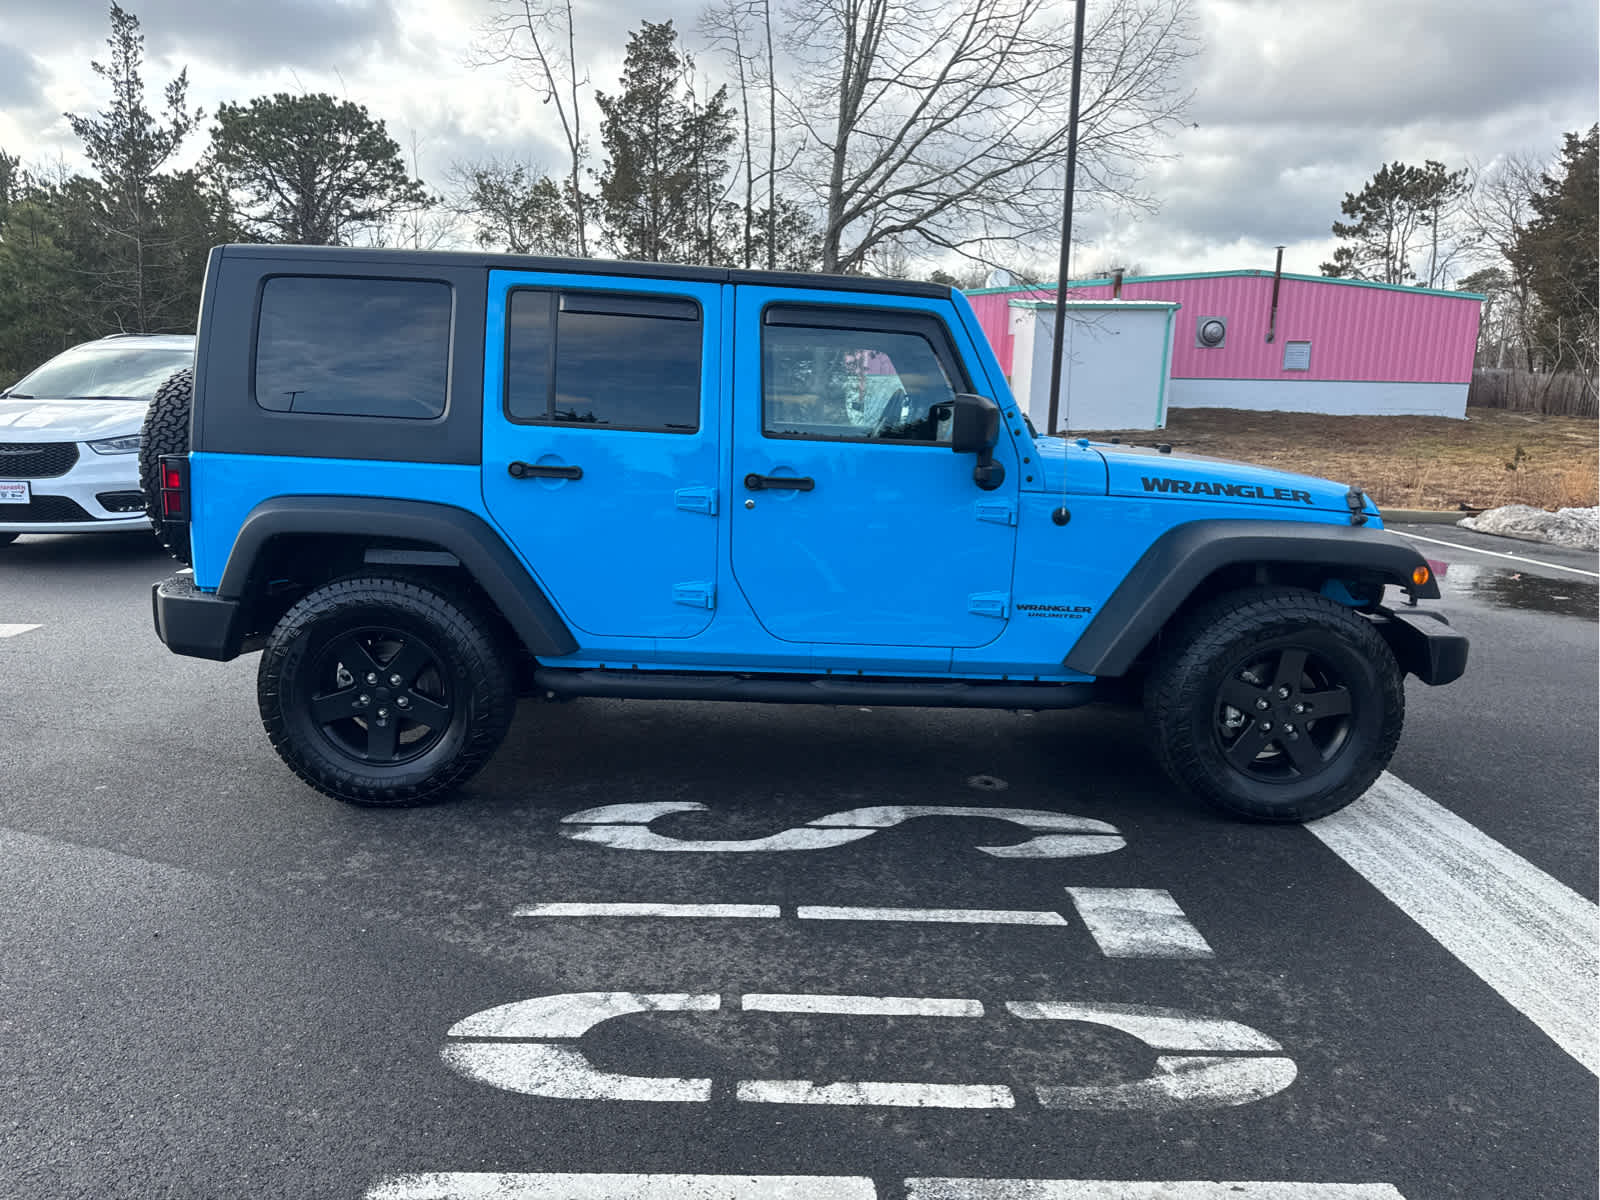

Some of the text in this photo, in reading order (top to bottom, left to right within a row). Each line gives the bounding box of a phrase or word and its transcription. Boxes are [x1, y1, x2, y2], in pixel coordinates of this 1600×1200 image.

[1141, 477, 1314, 505] WRANGLER
[1016, 604, 1092, 614] WRANGLER
[365, 801, 1409, 1200] STO
